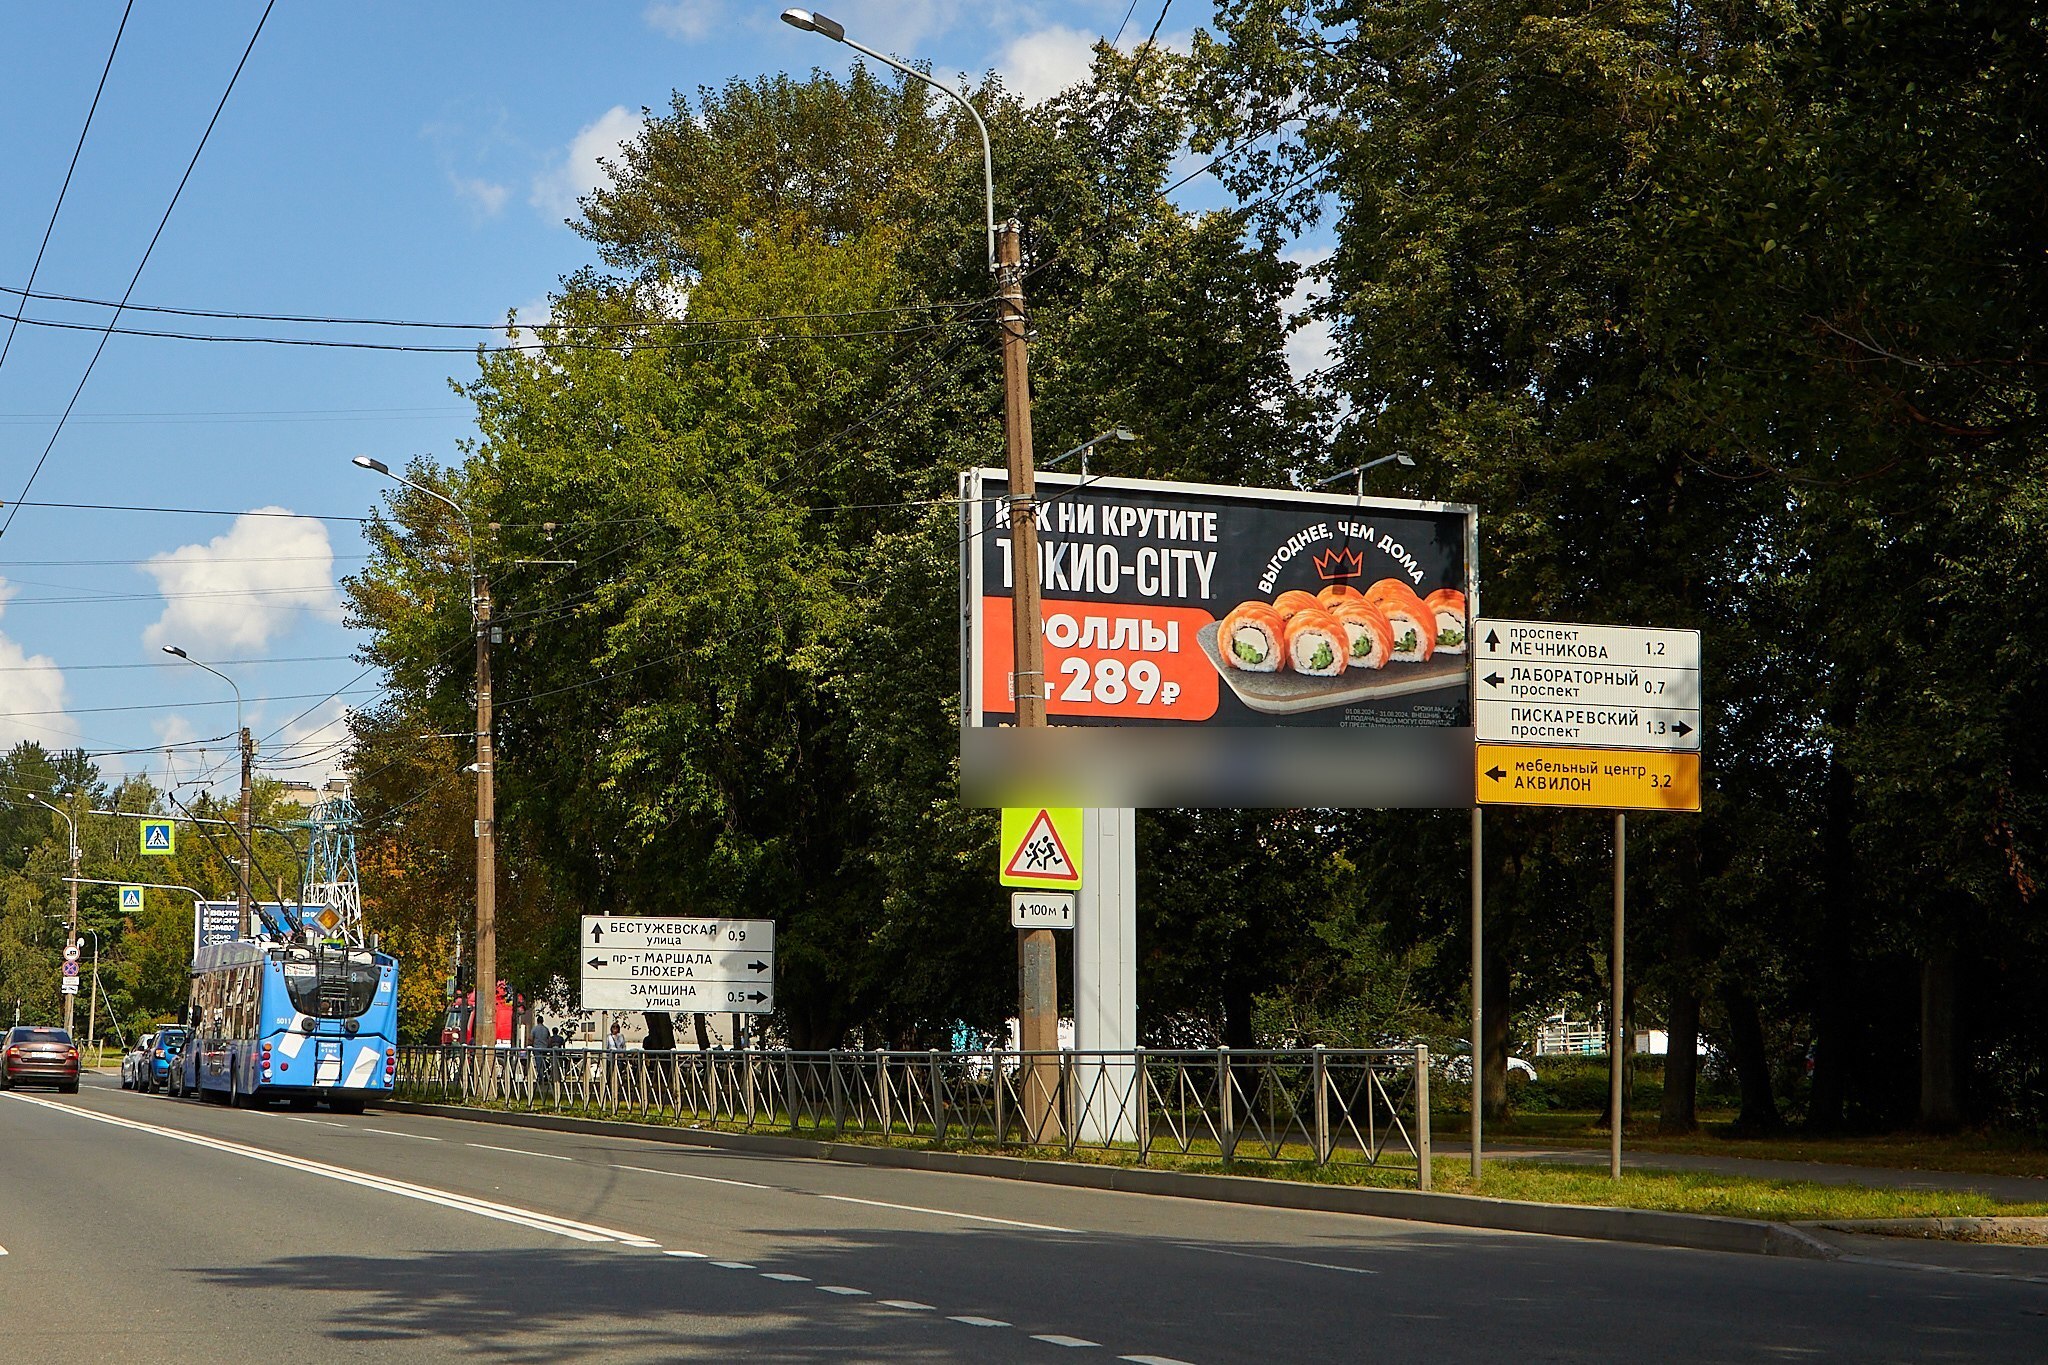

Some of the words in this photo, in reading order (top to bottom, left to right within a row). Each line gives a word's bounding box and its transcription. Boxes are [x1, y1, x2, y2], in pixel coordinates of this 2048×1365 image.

[995, 499, 1052, 532] КК
[1058, 502, 1095, 535] НИ
[1102, 505, 1218, 543] КРУТИТЕ
[1257, 522, 1334, 594] ВЫГОДНЕЕ,
[1337, 520, 1375, 543] ЧЕМ
[1376, 534, 1425, 585] ДОМА
[996, 539, 1218, 600] ТКИО-CITY
[1041, 613, 1179, 653] ОЛЛЫ
[1510, 628, 1579, 640] проспект
[1510, 642, 1609, 659] МЕЧНИКОВА
[1510, 667, 1639, 686] ЛАБОРАТОРНЫЙ
[1044, 682, 1055, 700] т
[1511, 685, 1580, 698] проспект
[1511, 708, 1639, 726] ПИСКАРЕВСКИЙ
[1511, 725, 1580, 738] проспект
[1515, 759, 1598, 774] мебельный
[1604, 764, 1646, 779] центр
[1514, 776, 1591, 791] АКВИЛОН
[610, 922, 717, 936] БЕСТУЖЕВСКАЯ
[646, 936, 681, 947] улица
[612, 954, 640, 965] пр-т
[644, 952, 713, 965] МАРШАЛА
[631, 966, 694, 977] БЛЮХЕРА
[630, 984, 697, 996] ЗАМШИНА
[645, 997, 681, 1008] улица
